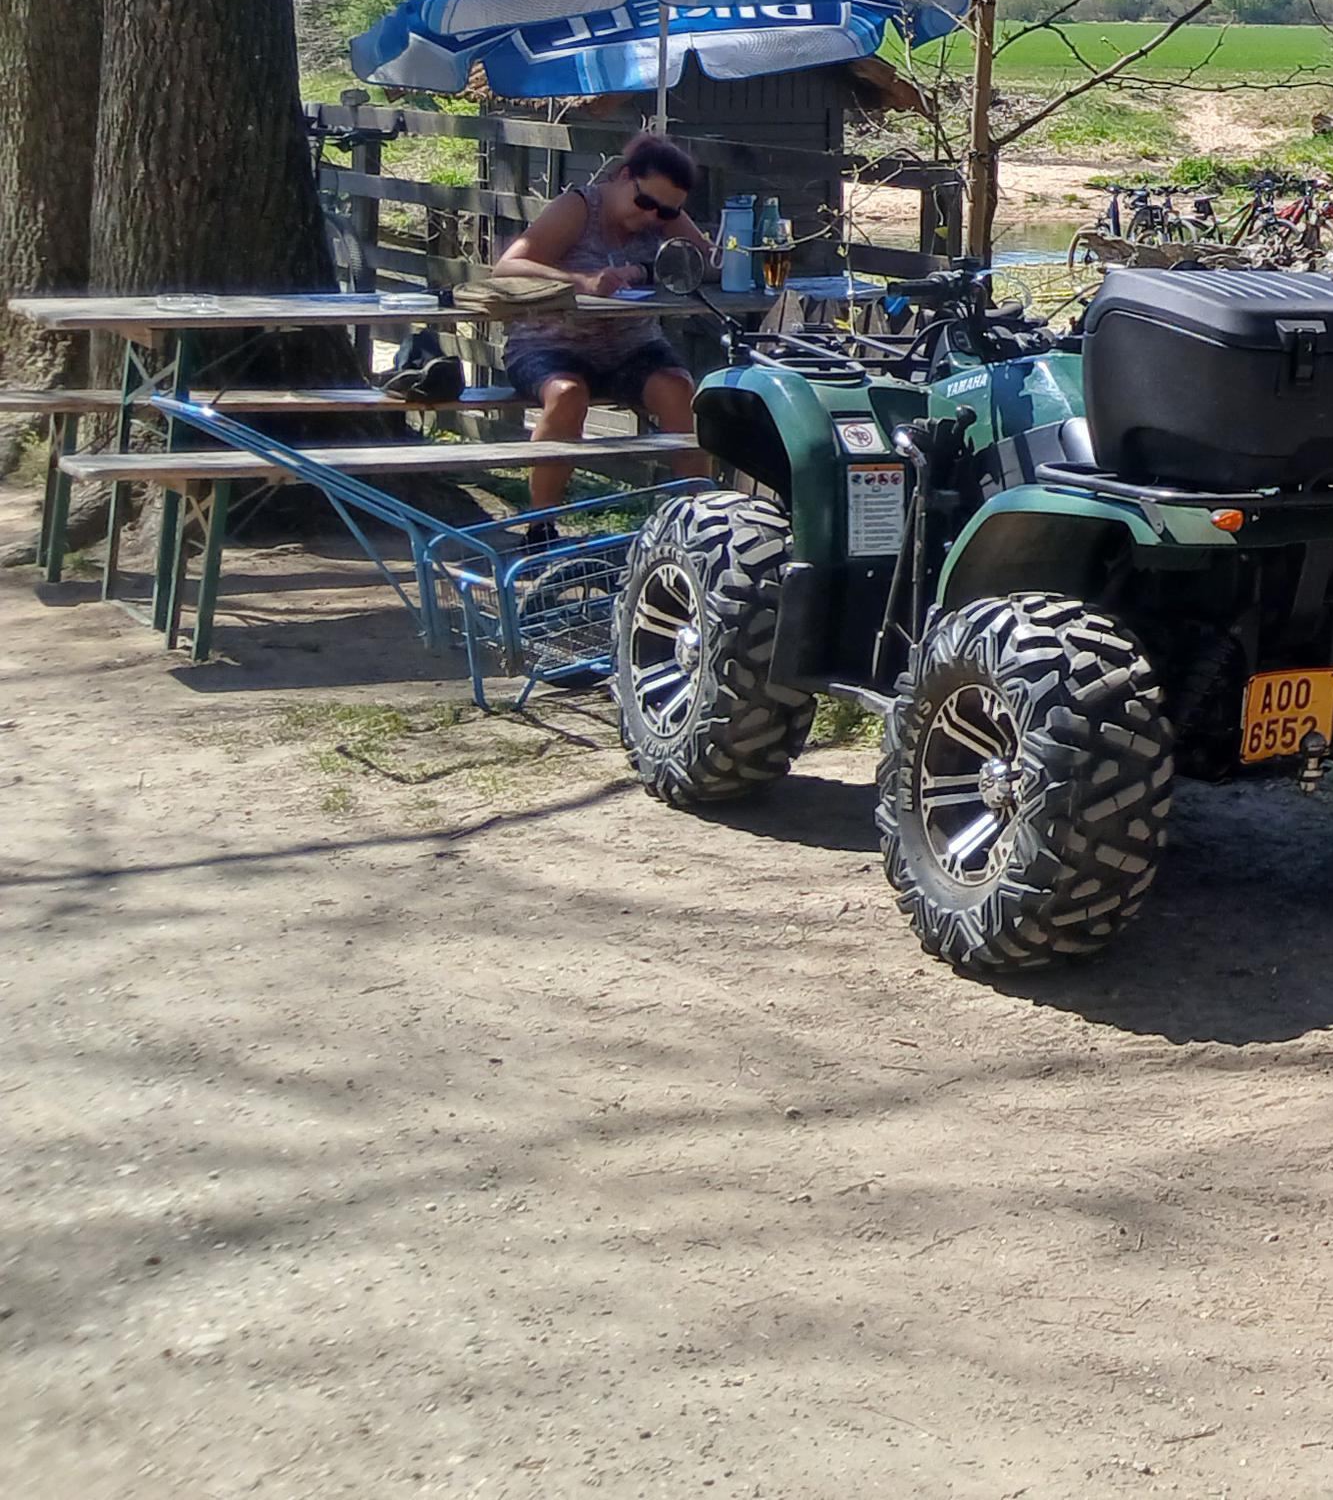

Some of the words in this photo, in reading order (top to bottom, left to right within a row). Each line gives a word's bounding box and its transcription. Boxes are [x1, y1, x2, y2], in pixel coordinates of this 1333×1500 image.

[946, 373, 988, 398] YAMAHA
[1249, 716, 1317, 753] 6552
[899, 697, 932, 811] MAXXIS
